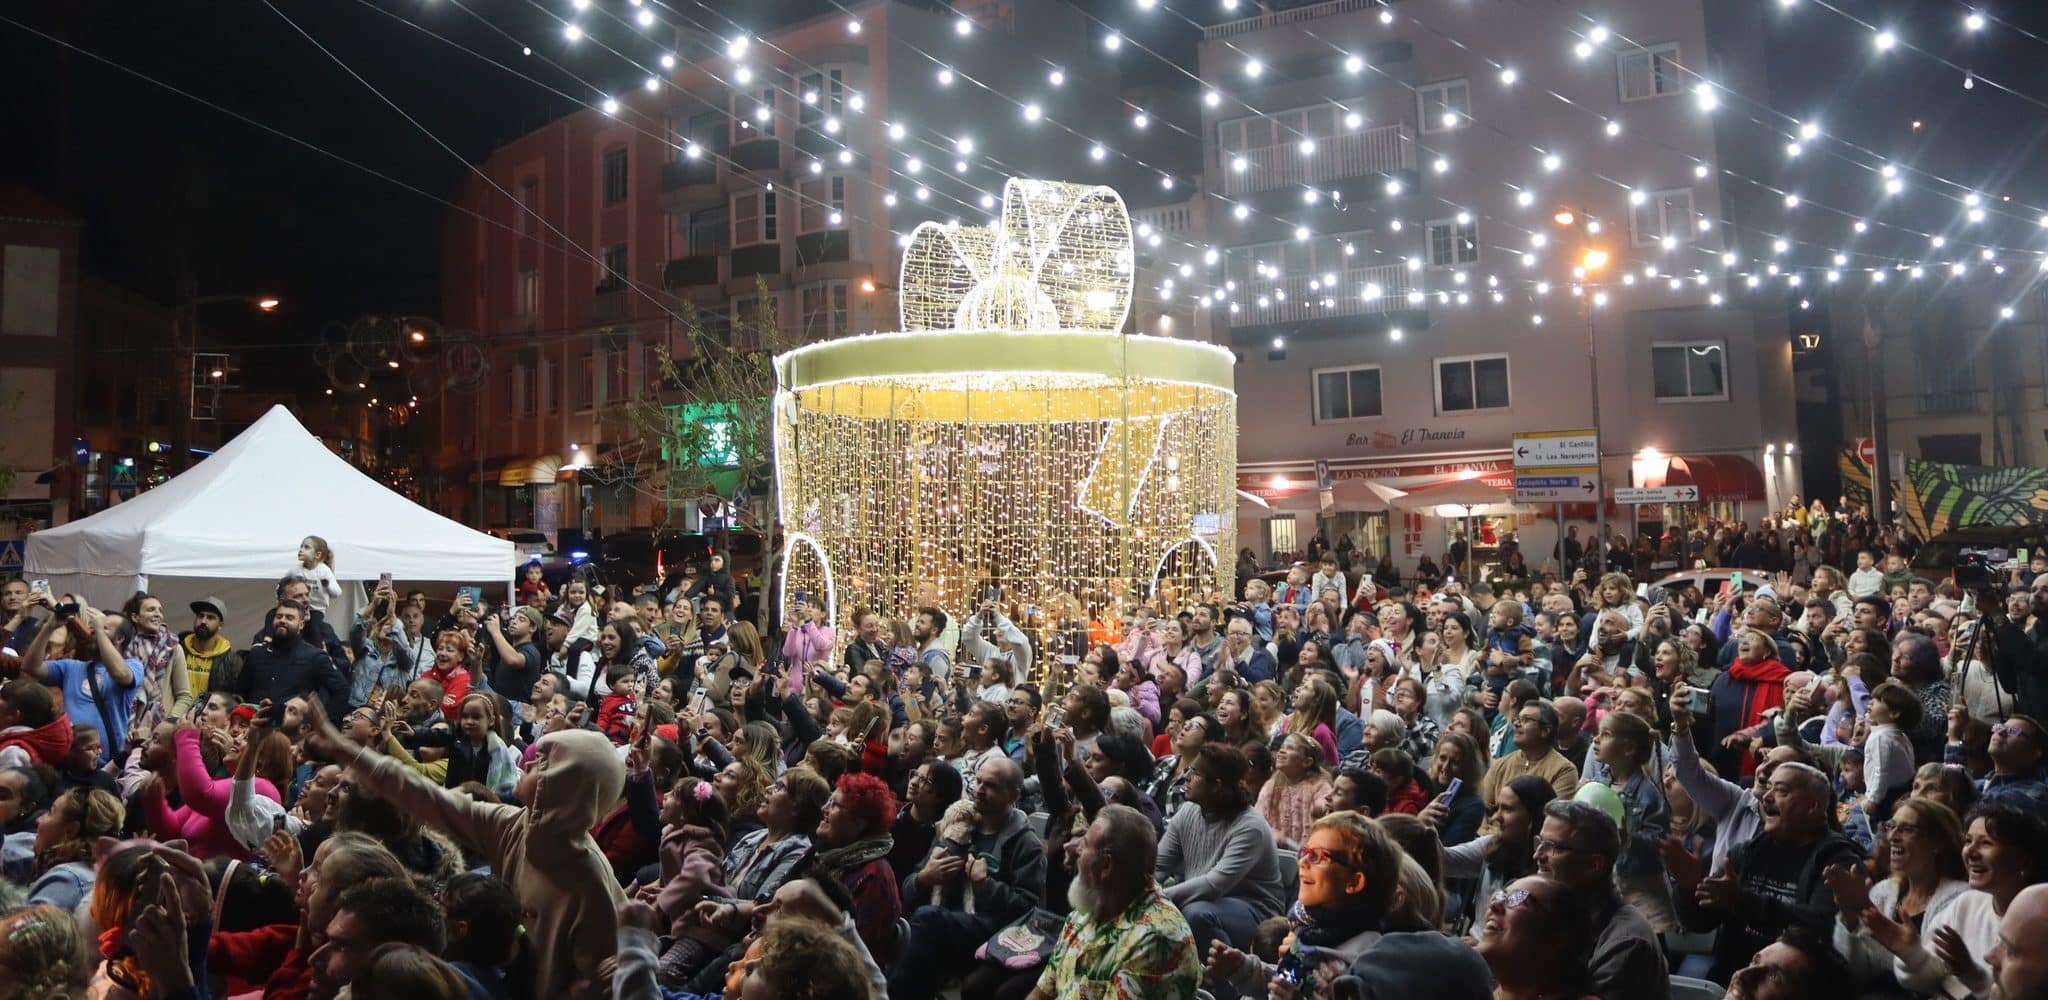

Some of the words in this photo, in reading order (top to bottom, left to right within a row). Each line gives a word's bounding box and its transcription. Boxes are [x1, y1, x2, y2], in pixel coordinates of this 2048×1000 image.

[1346, 433, 1369, 446] Bar
[1401, 429, 1415, 446] El
[1434, 465, 1447, 475] EL
